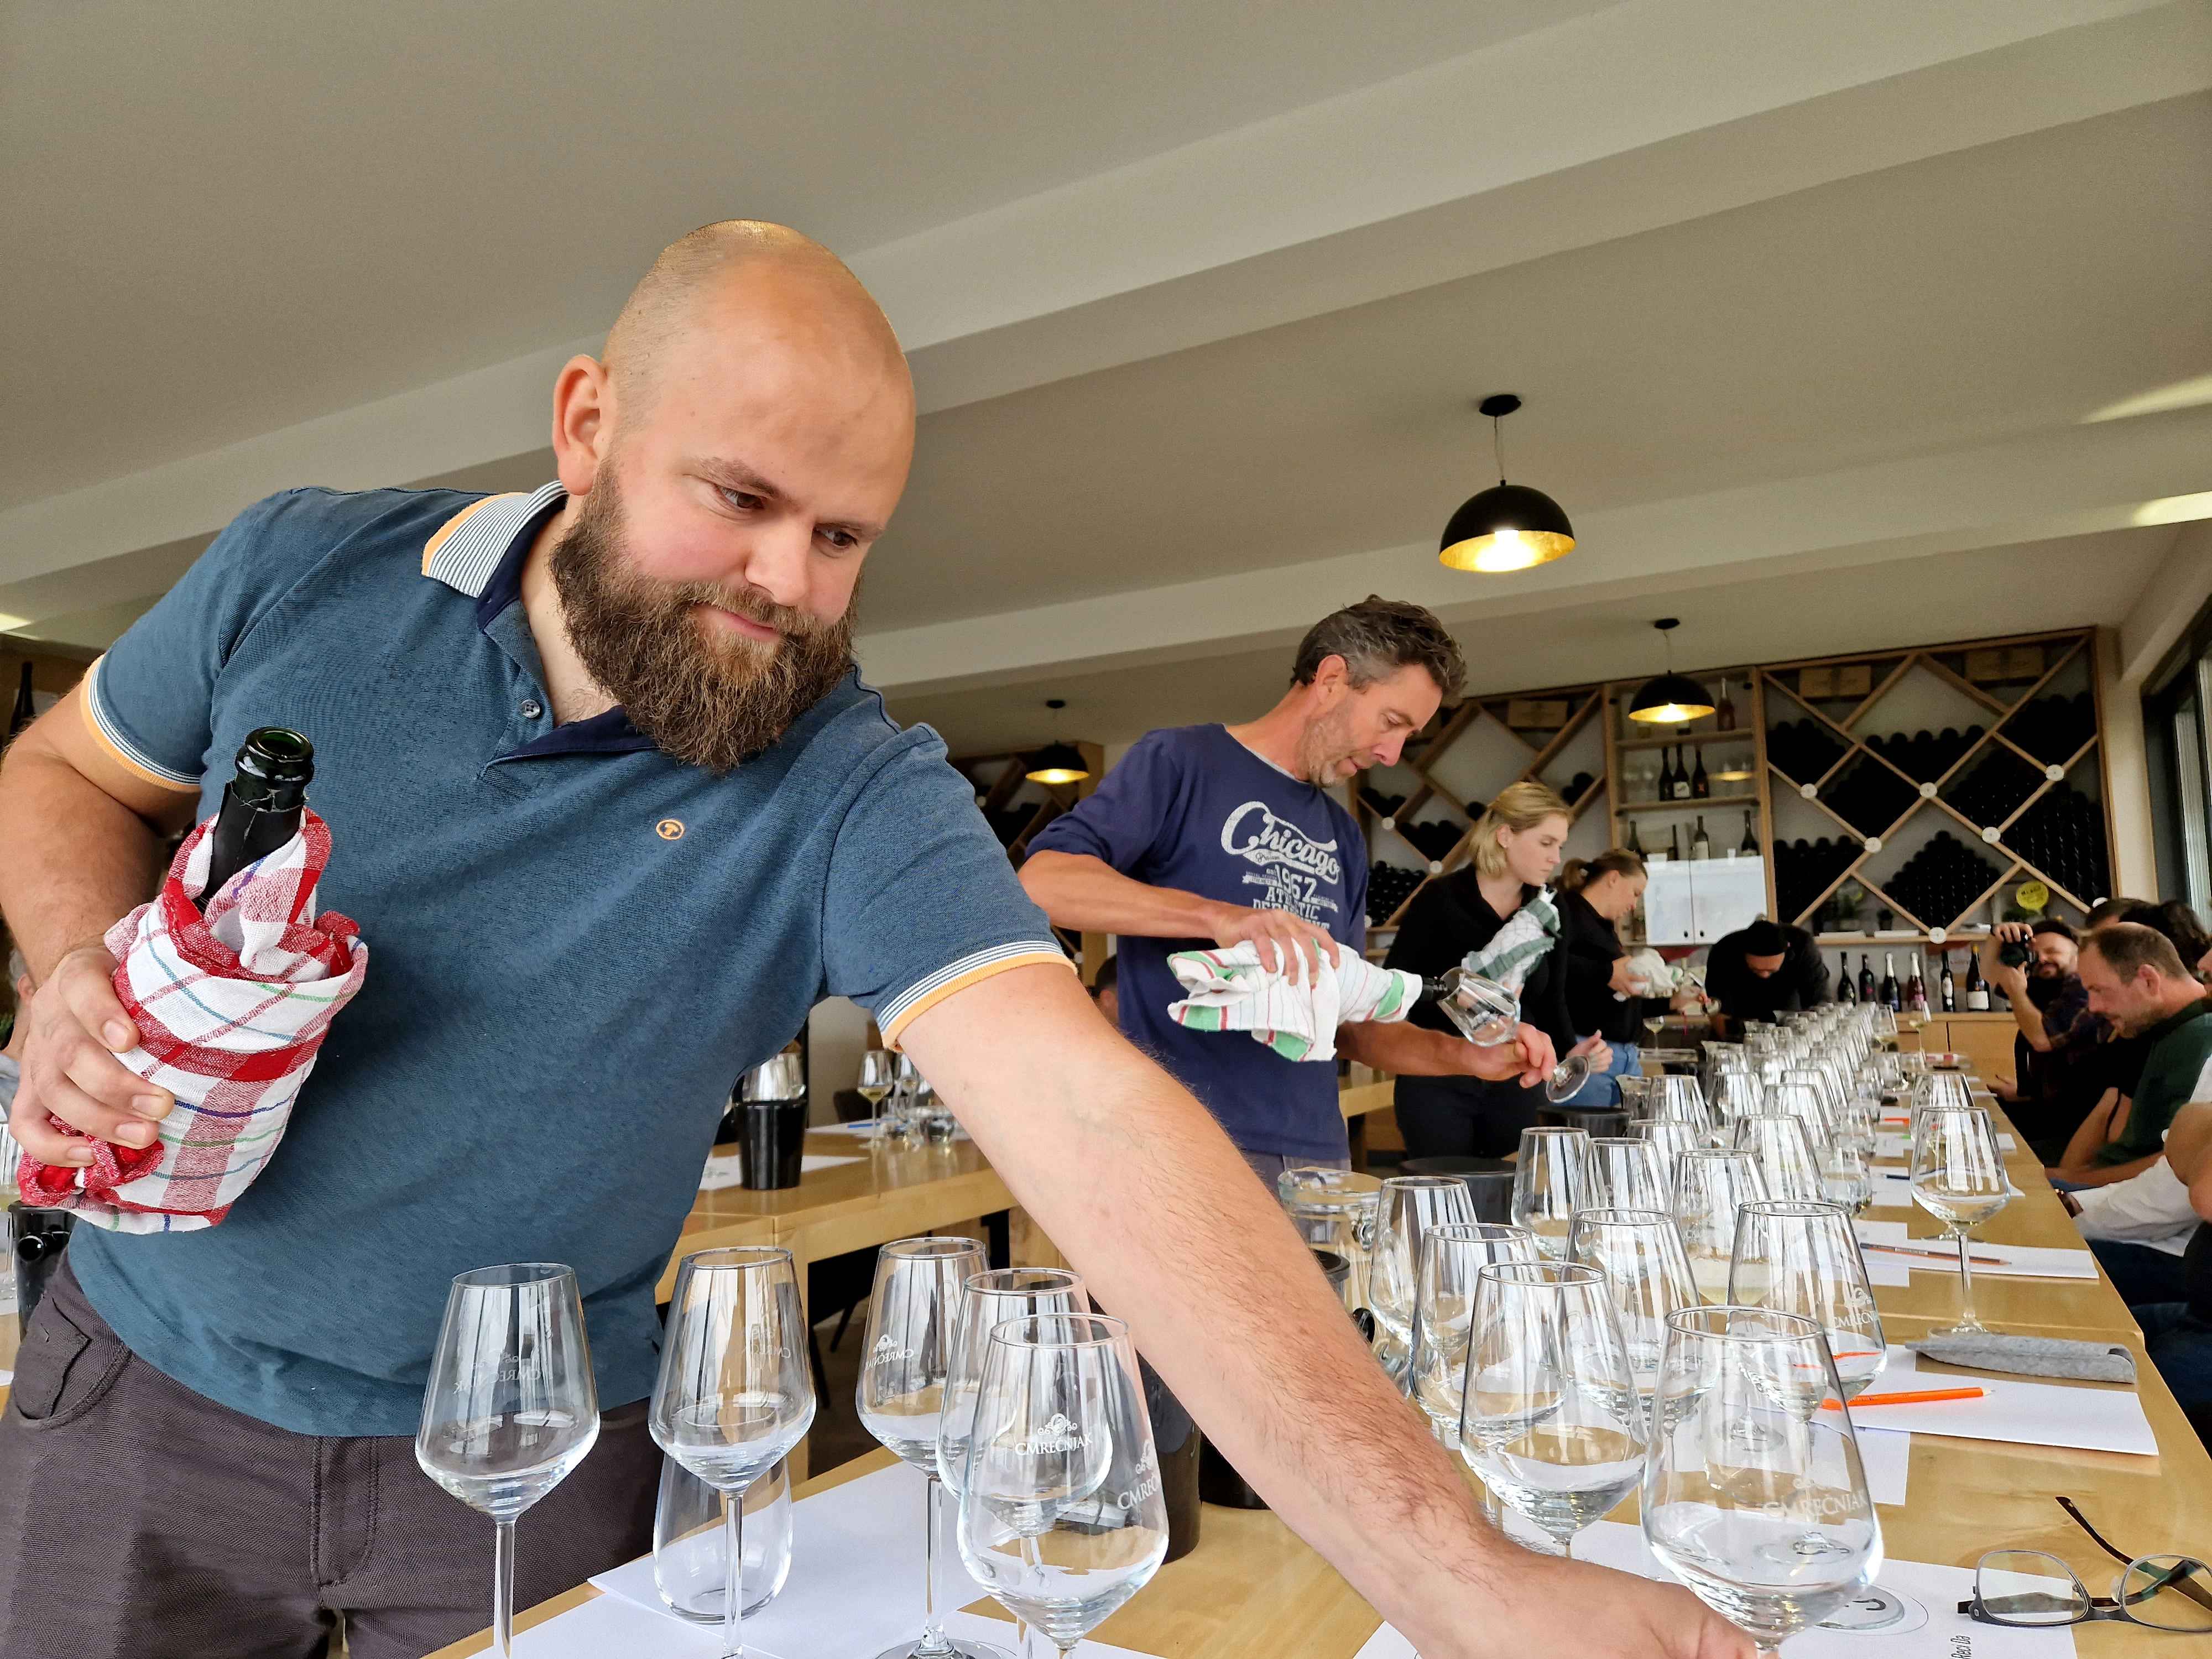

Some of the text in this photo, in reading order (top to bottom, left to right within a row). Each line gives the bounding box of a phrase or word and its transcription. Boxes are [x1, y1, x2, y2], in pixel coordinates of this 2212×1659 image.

[1221, 801, 1340, 877] Chicago
[1265, 886, 1321, 920] ATTIC
[1015, 1432, 1093, 1456] CMREČNJAK
[1950, 1635, 1971, 1645] Da
